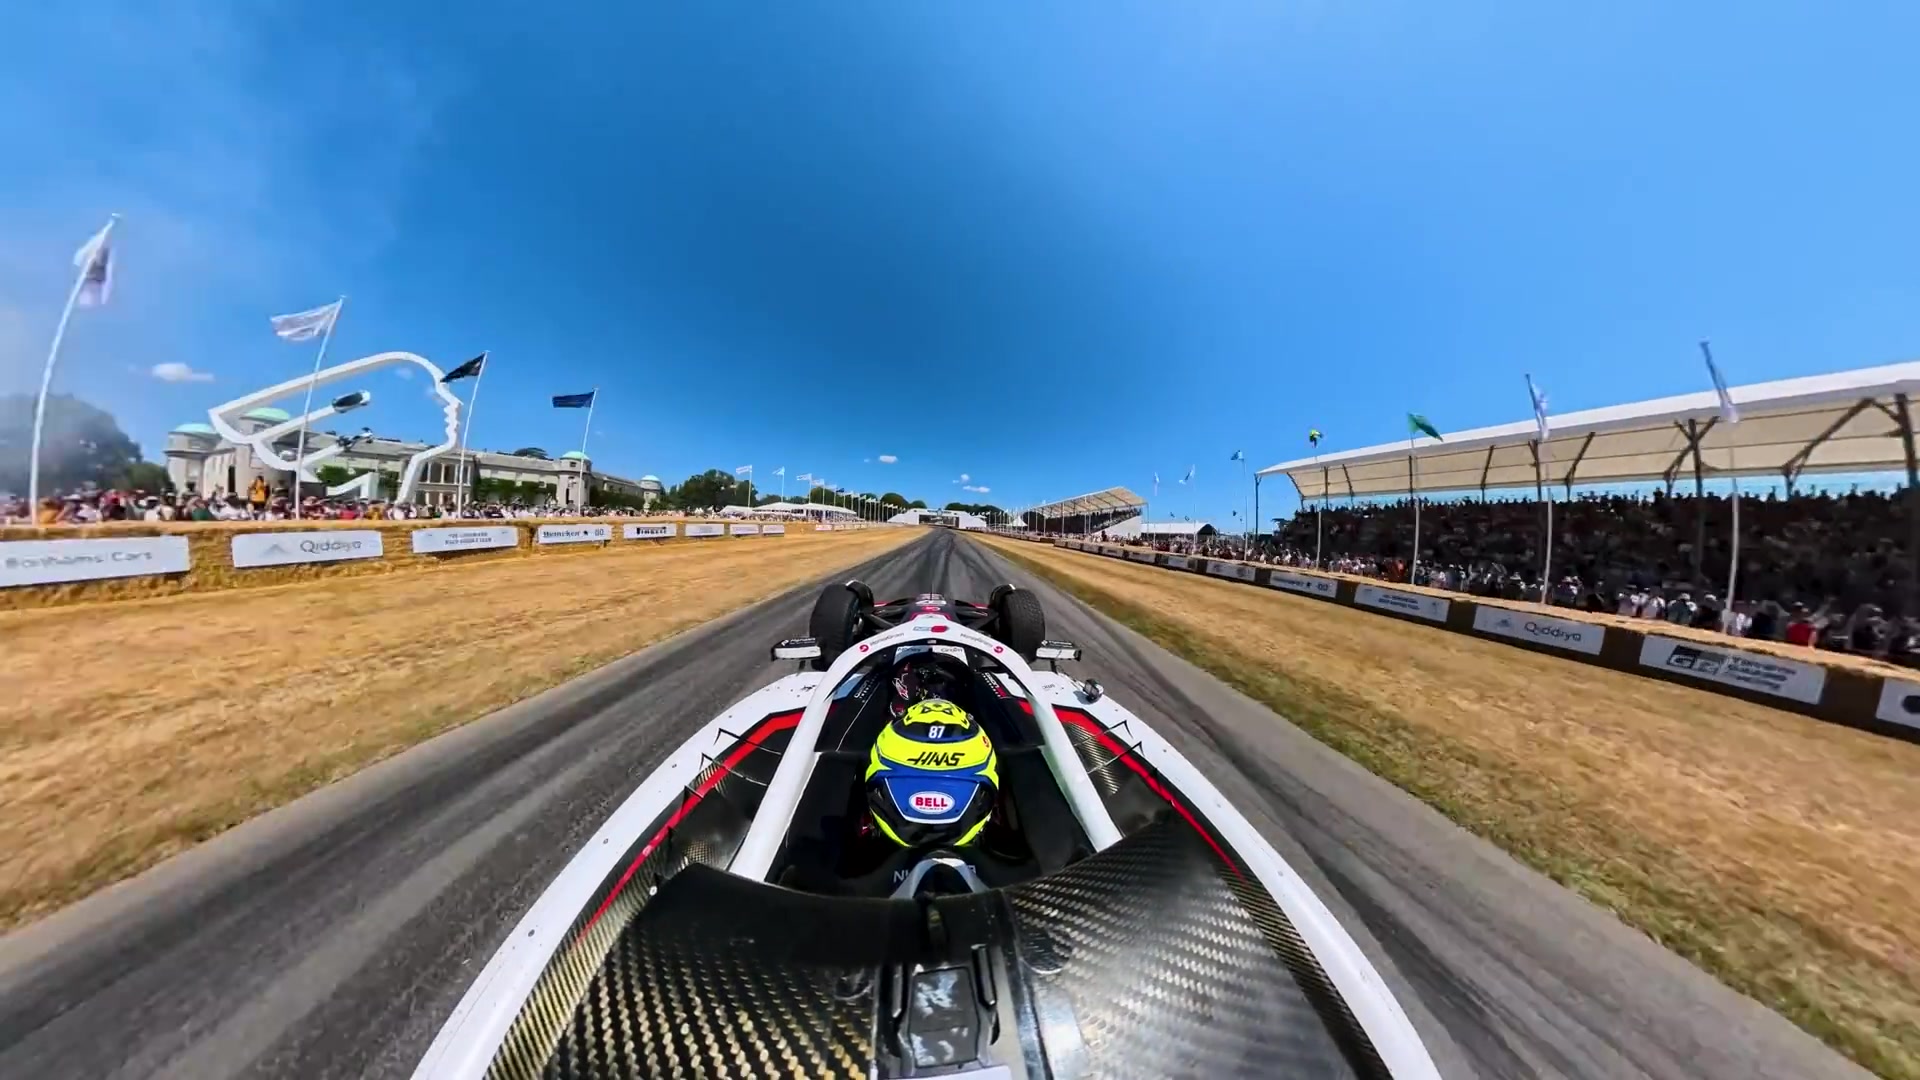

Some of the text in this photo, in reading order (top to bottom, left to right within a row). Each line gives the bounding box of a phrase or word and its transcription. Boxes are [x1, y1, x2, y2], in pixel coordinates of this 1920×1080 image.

[111, 551, 153, 562] Cars
[928, 725, 945, 739] 87
[906, 751, 965, 766] HAAS
[915, 796, 948, 808] BELL
